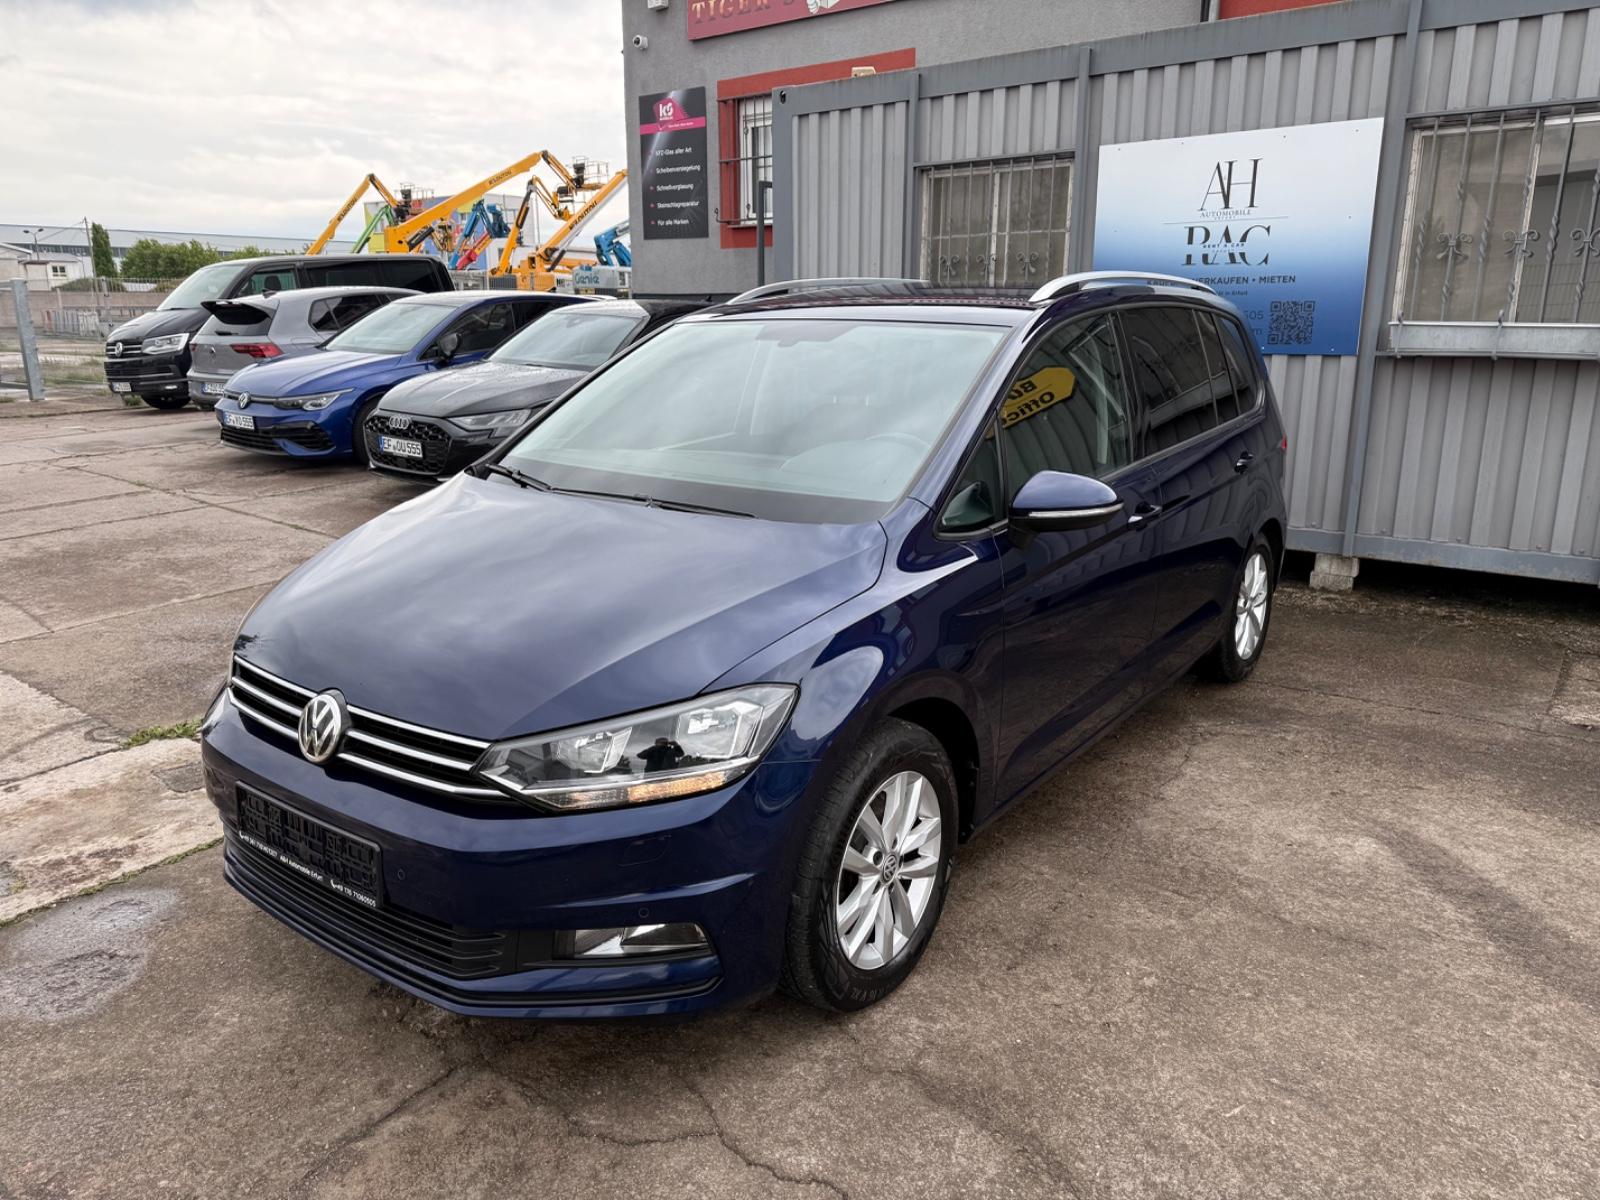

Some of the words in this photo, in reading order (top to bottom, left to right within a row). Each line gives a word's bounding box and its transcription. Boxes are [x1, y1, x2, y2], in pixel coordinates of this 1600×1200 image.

[1197, 157, 1263, 211] AH
[1200, 209, 1251, 218] AUTOMOBILE
[1180, 224, 1272, 266] RAC
[1258, 275, 1296, 284] MIETEN
